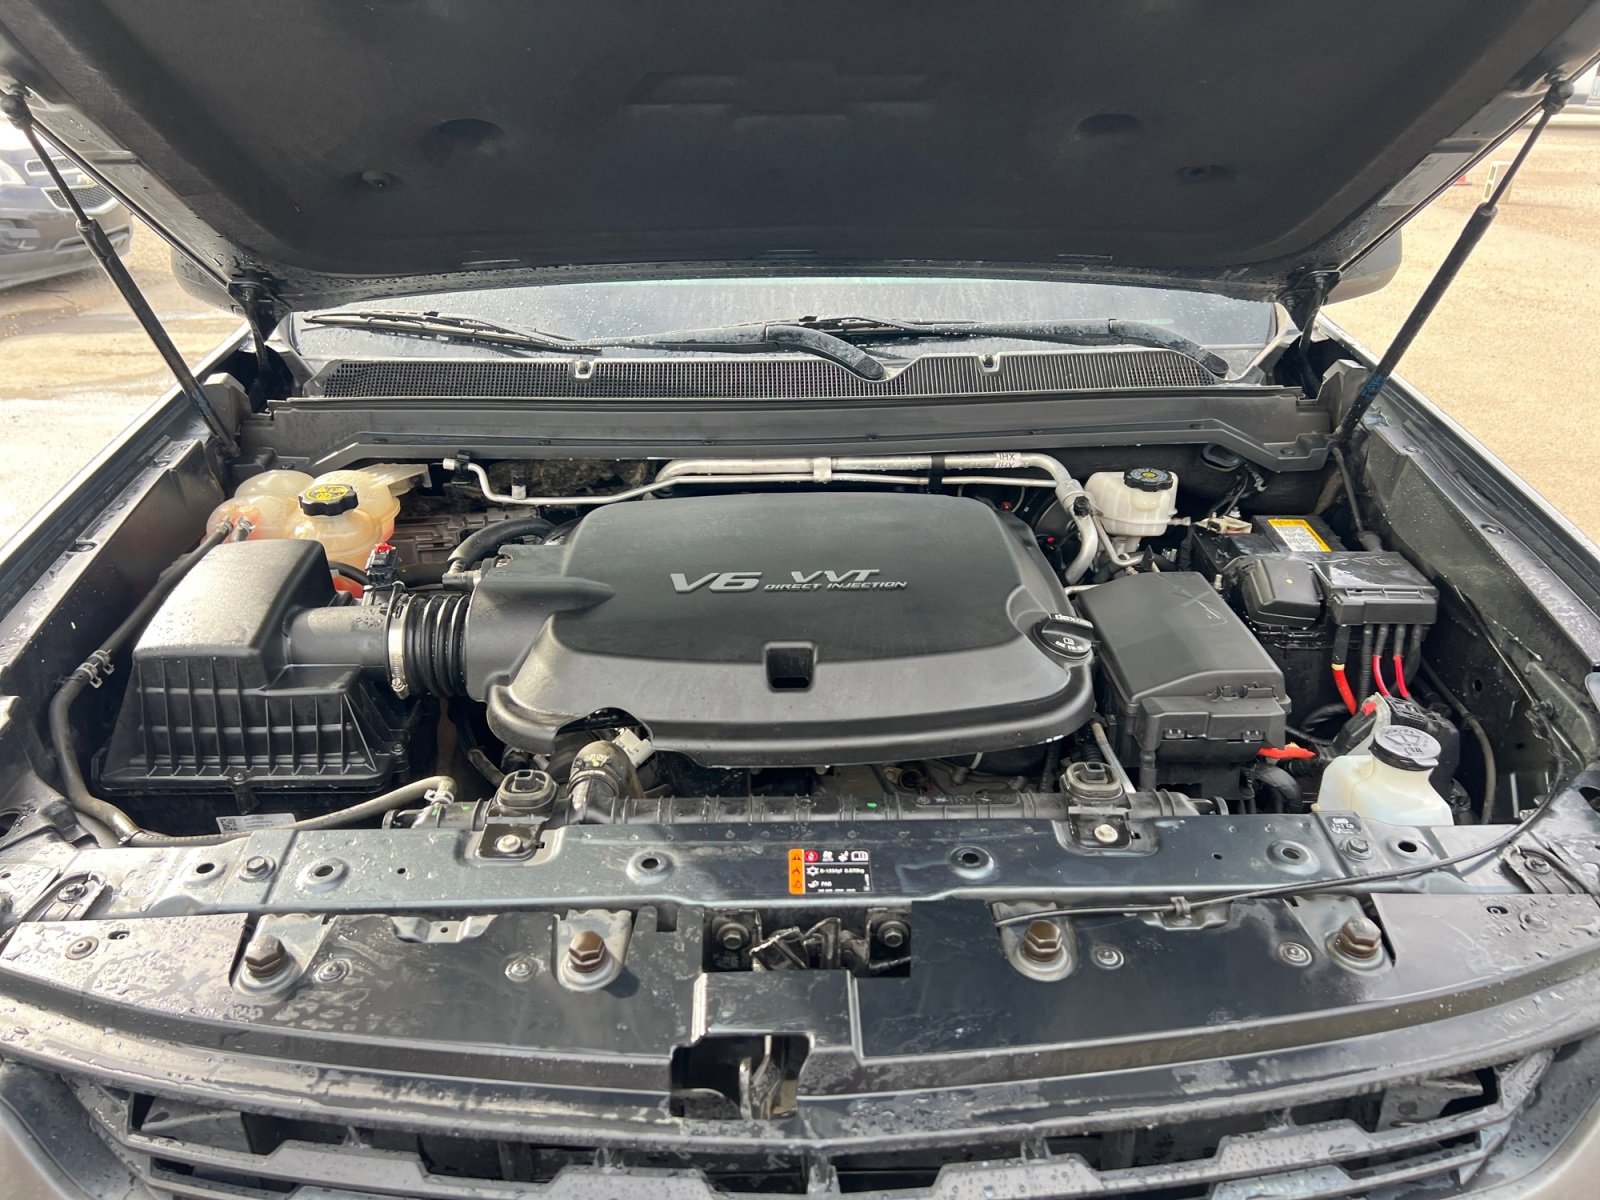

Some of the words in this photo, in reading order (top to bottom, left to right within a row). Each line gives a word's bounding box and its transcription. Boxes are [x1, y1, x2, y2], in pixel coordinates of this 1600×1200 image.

[670, 572, 762, 593] V6
[791, 569, 880, 583] VVT
[764, 583, 823, 592] DIRECT
[827, 581, 908, 591] INJECTION
